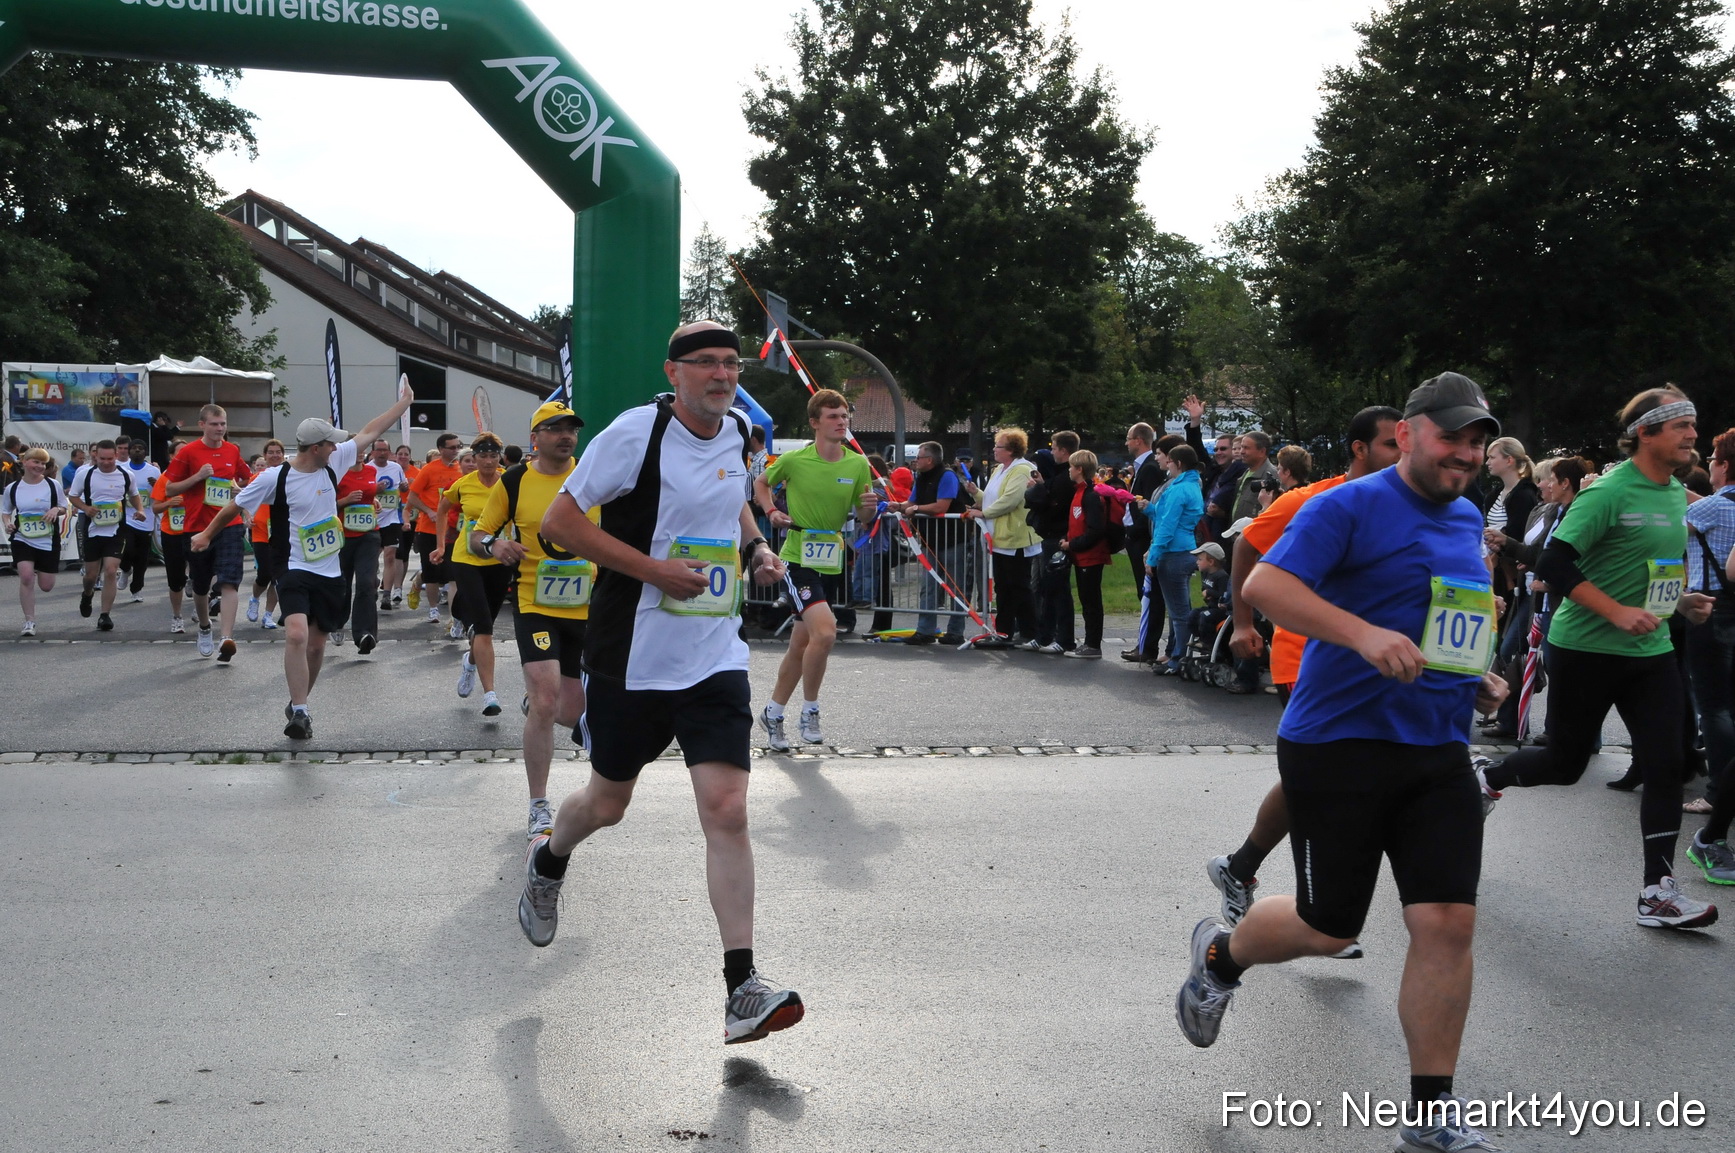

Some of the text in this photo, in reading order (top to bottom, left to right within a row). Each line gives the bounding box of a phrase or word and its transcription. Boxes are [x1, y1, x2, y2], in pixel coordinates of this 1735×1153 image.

[481, 55, 639, 188] AOK
[14, 383, 63, 399] TLA
[70, 392, 126, 408] Logistics
[207, 486, 230, 500] 1141
[96, 511, 117, 519] 314
[345, 514, 373, 525] 1156
[24, 522, 46, 532] 313
[306, 529, 336, 553] 318
[805, 542, 836, 559] 377
[543, 576, 582, 596] 771
[1649, 580, 1680, 602] 1193
[1435, 609, 1484, 650] 107
[537, 637, 549, 646] FC
